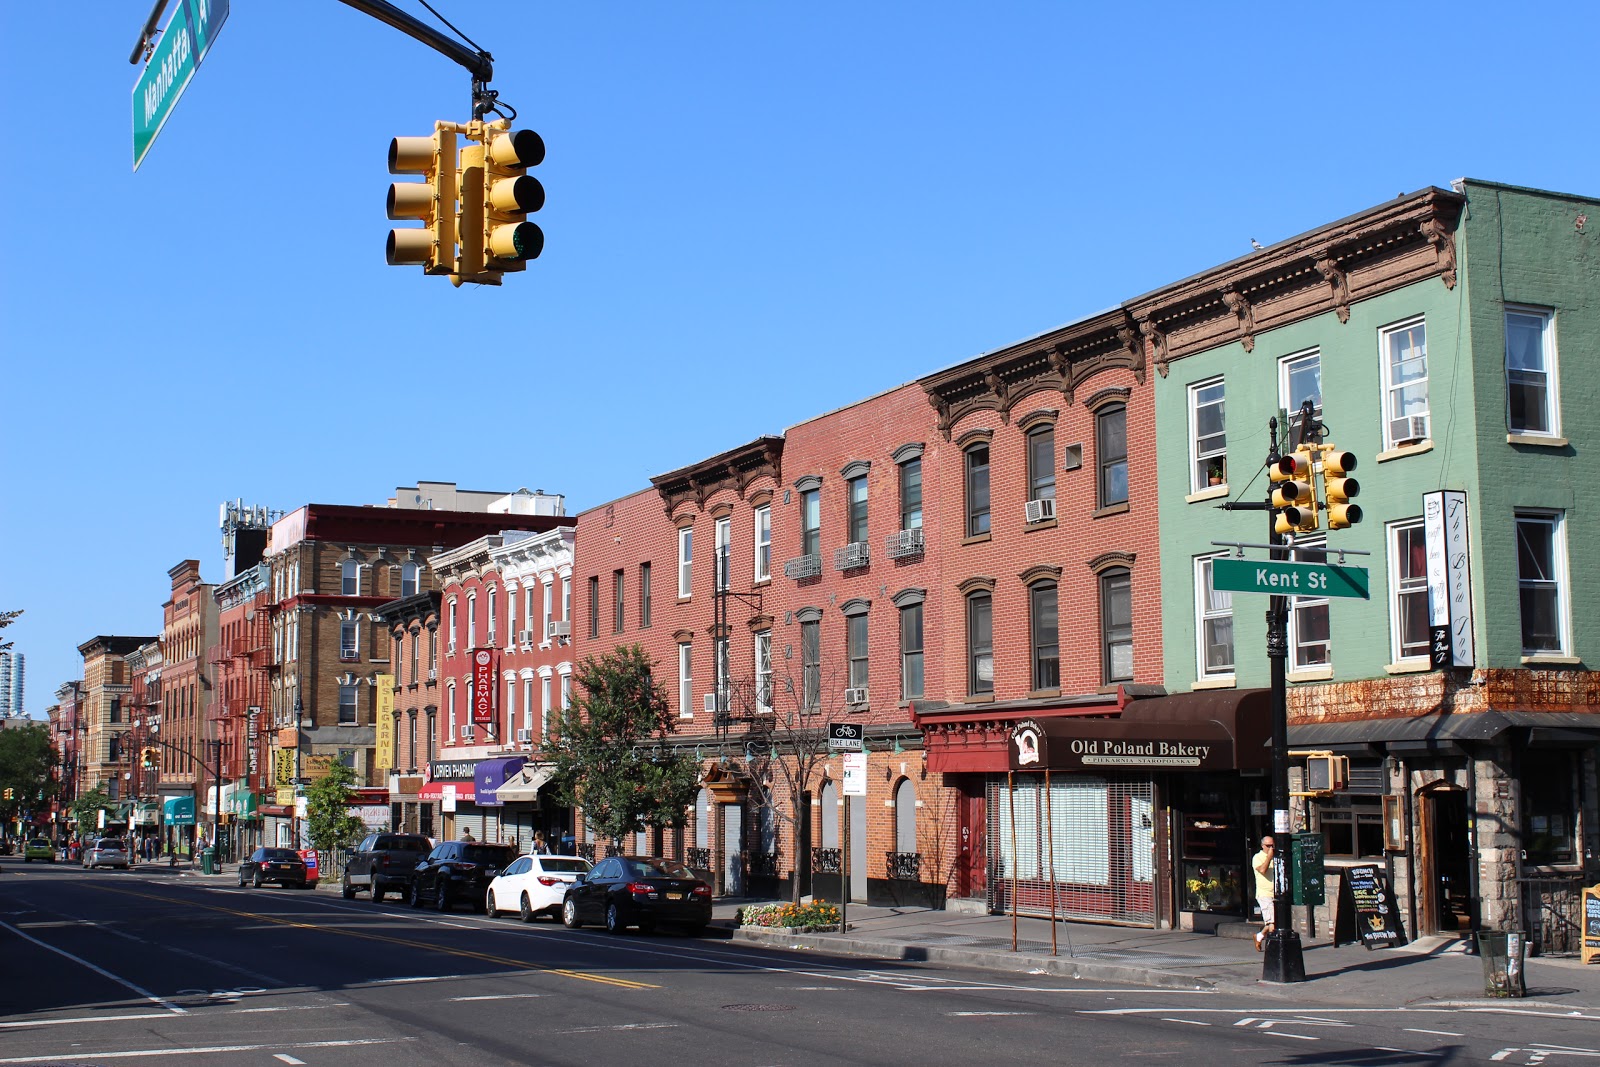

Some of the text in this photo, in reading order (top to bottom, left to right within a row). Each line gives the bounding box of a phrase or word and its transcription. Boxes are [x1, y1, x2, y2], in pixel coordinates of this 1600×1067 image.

[1256, 568, 1327, 589] Kent St
[477, 666, 489, 716] PHARMACY
[830, 739, 860, 748] BIKE LANE
[1070, 740, 1210, 760] Old Poland Bakery
[453, 763, 477, 777] PHARMAC
